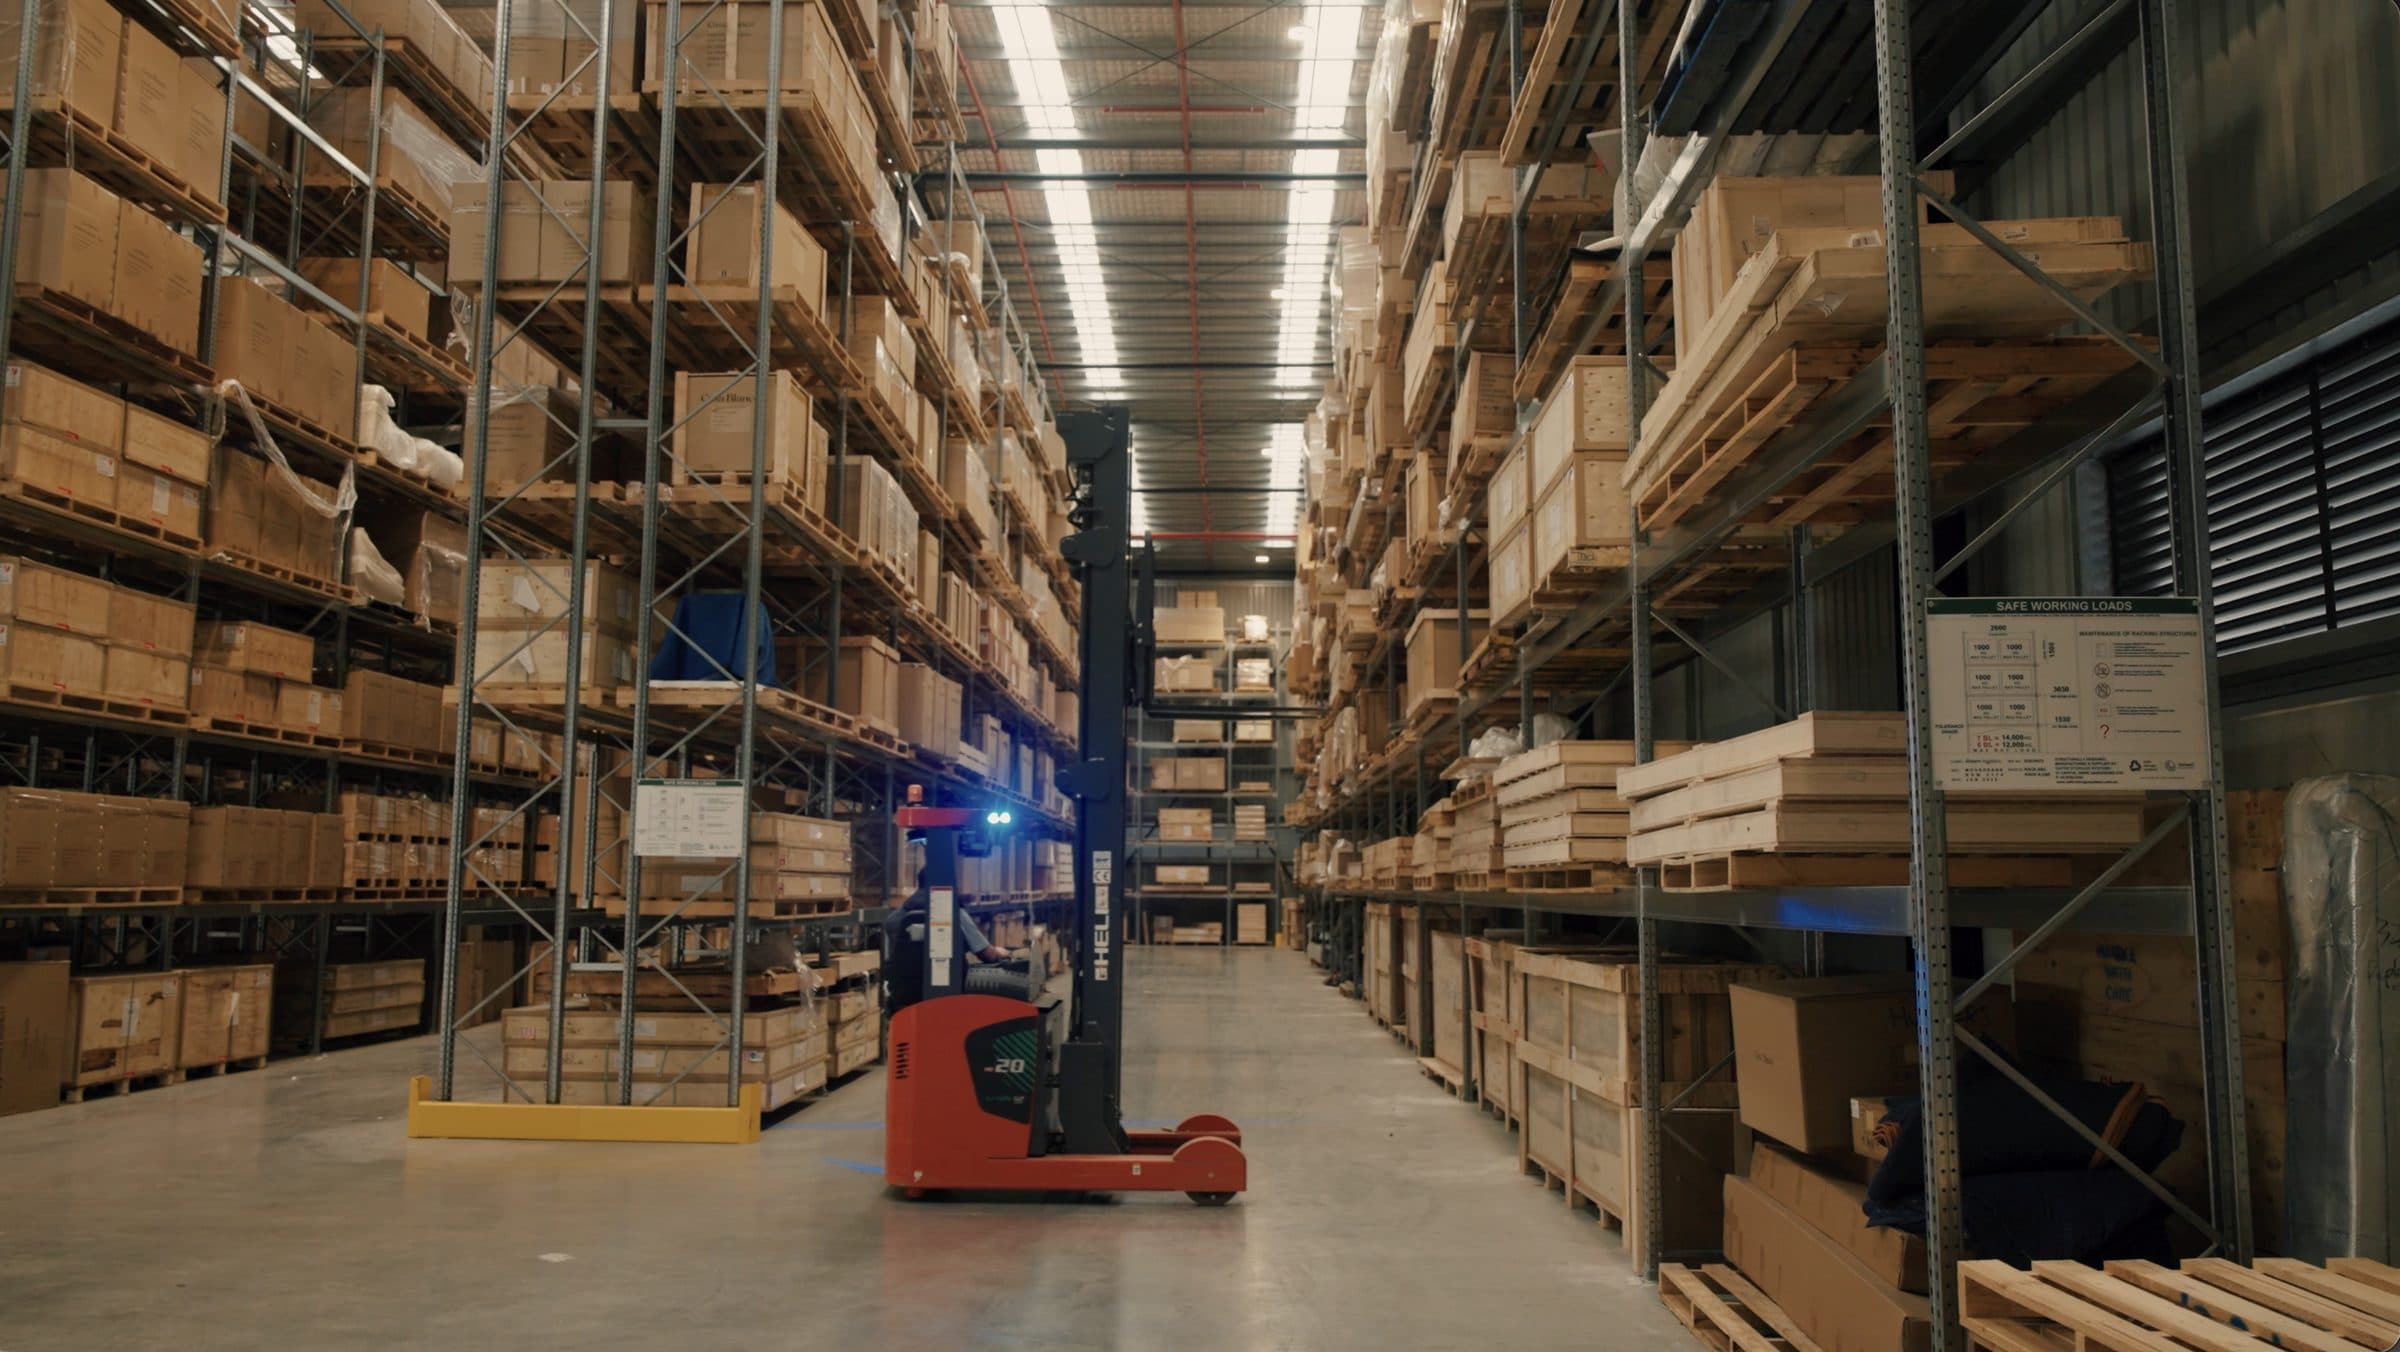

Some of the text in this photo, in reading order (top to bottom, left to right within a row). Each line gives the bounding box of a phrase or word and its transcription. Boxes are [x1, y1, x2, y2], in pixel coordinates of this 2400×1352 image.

[1996, 601, 2132, 611] SAFE WORKING LOADS
